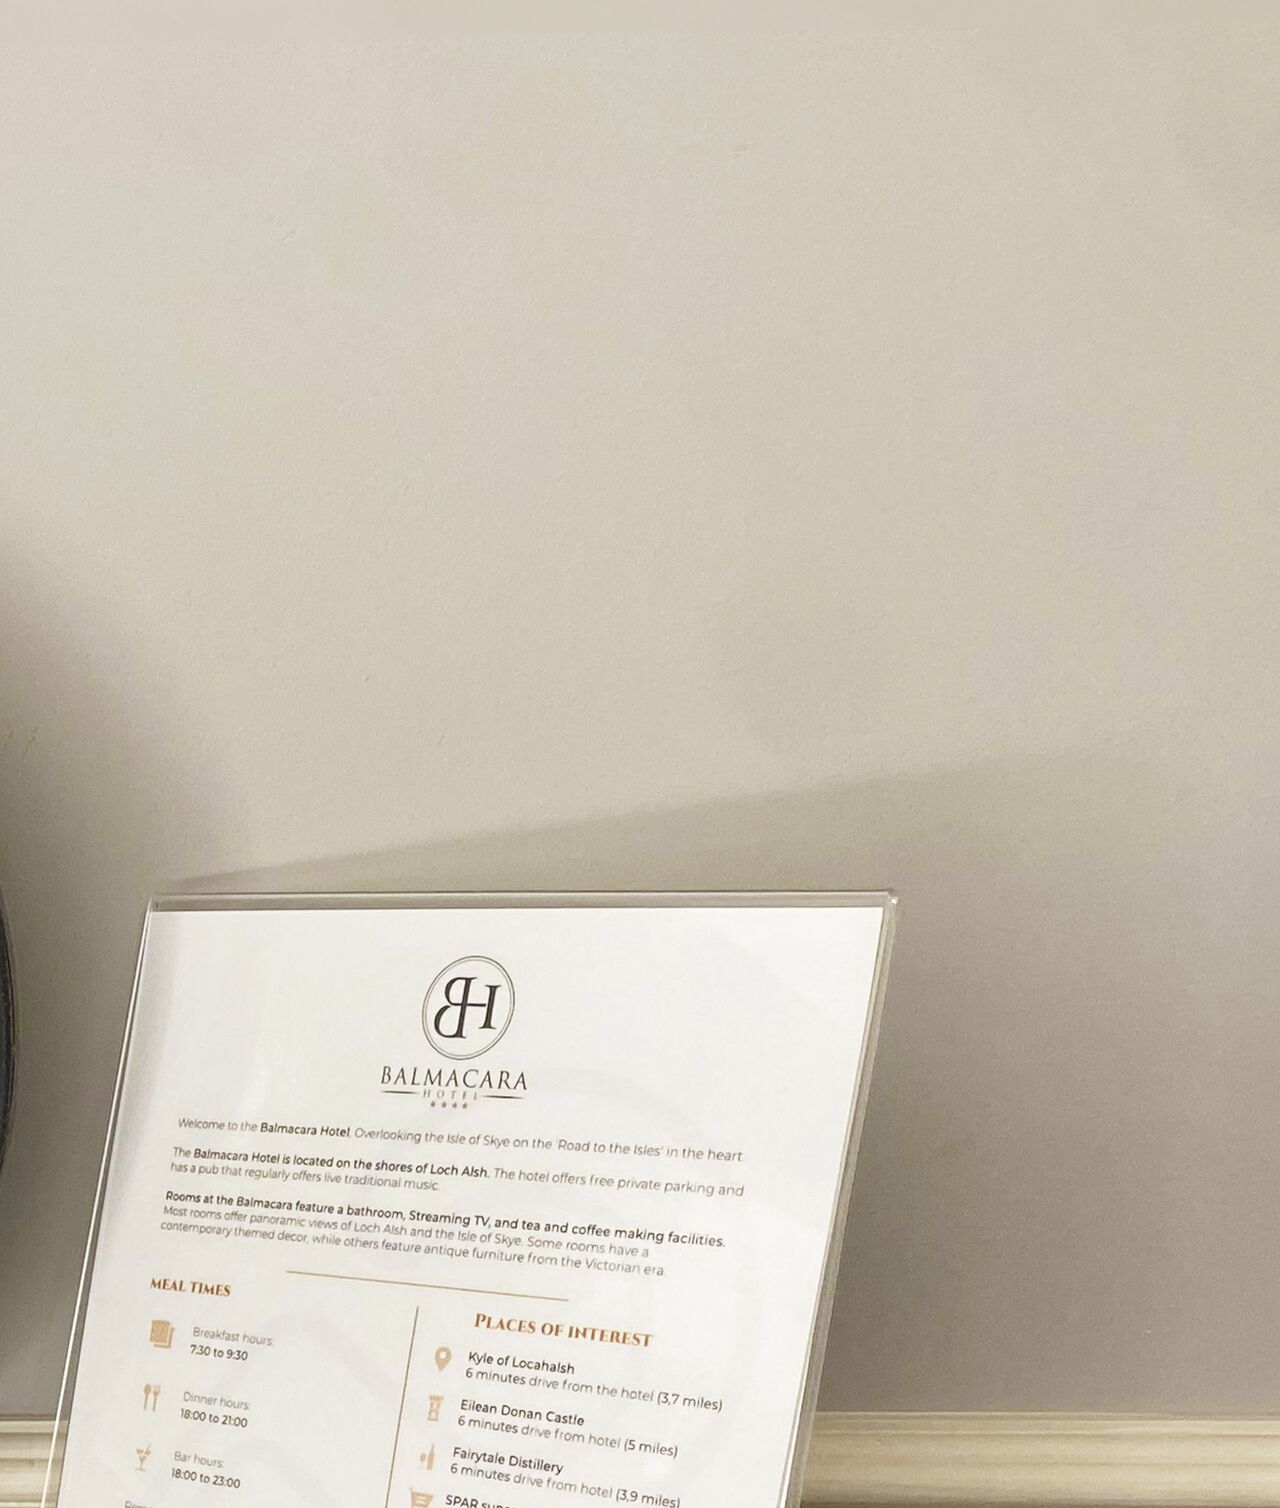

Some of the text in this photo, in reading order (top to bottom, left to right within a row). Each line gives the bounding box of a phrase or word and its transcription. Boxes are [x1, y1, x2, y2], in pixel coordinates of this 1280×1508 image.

[380, 1064, 528, 1091] BALMACARA
[421, 1087, 484, 1102] HOTEL
[150, 1277, 232, 1298] MEAL TIMES
[191, 1325, 241, 1343] Breakfast
[474, 1312, 652, 1348] PLACES OF INTEREST
[189, 1343, 249, 1362] 7:30 to 9:30
[467, 1350, 576, 1375] Kyle of Locahalsh
[182, 1390, 219, 1407] Dinner
[474, 1369, 527, 1386] minutes
[527, 1375, 560, 1391] drive
[561, 1377, 594, 1394] from
[595, 1383, 619, 1398] the
[620, 1386, 655, 1403] hotel
[681, 1396, 724, 1414] miles)
[180, 1407, 249, 1429] 18:00 to 21:00
[459, 1398, 586, 1427] Eilean Donan Castle
[173, 1449, 192, 1463] Bar
[452, 1446, 565, 1477] Fairytale Distillery
[170, 1467, 242, 1490] 18:00 to 23:00
